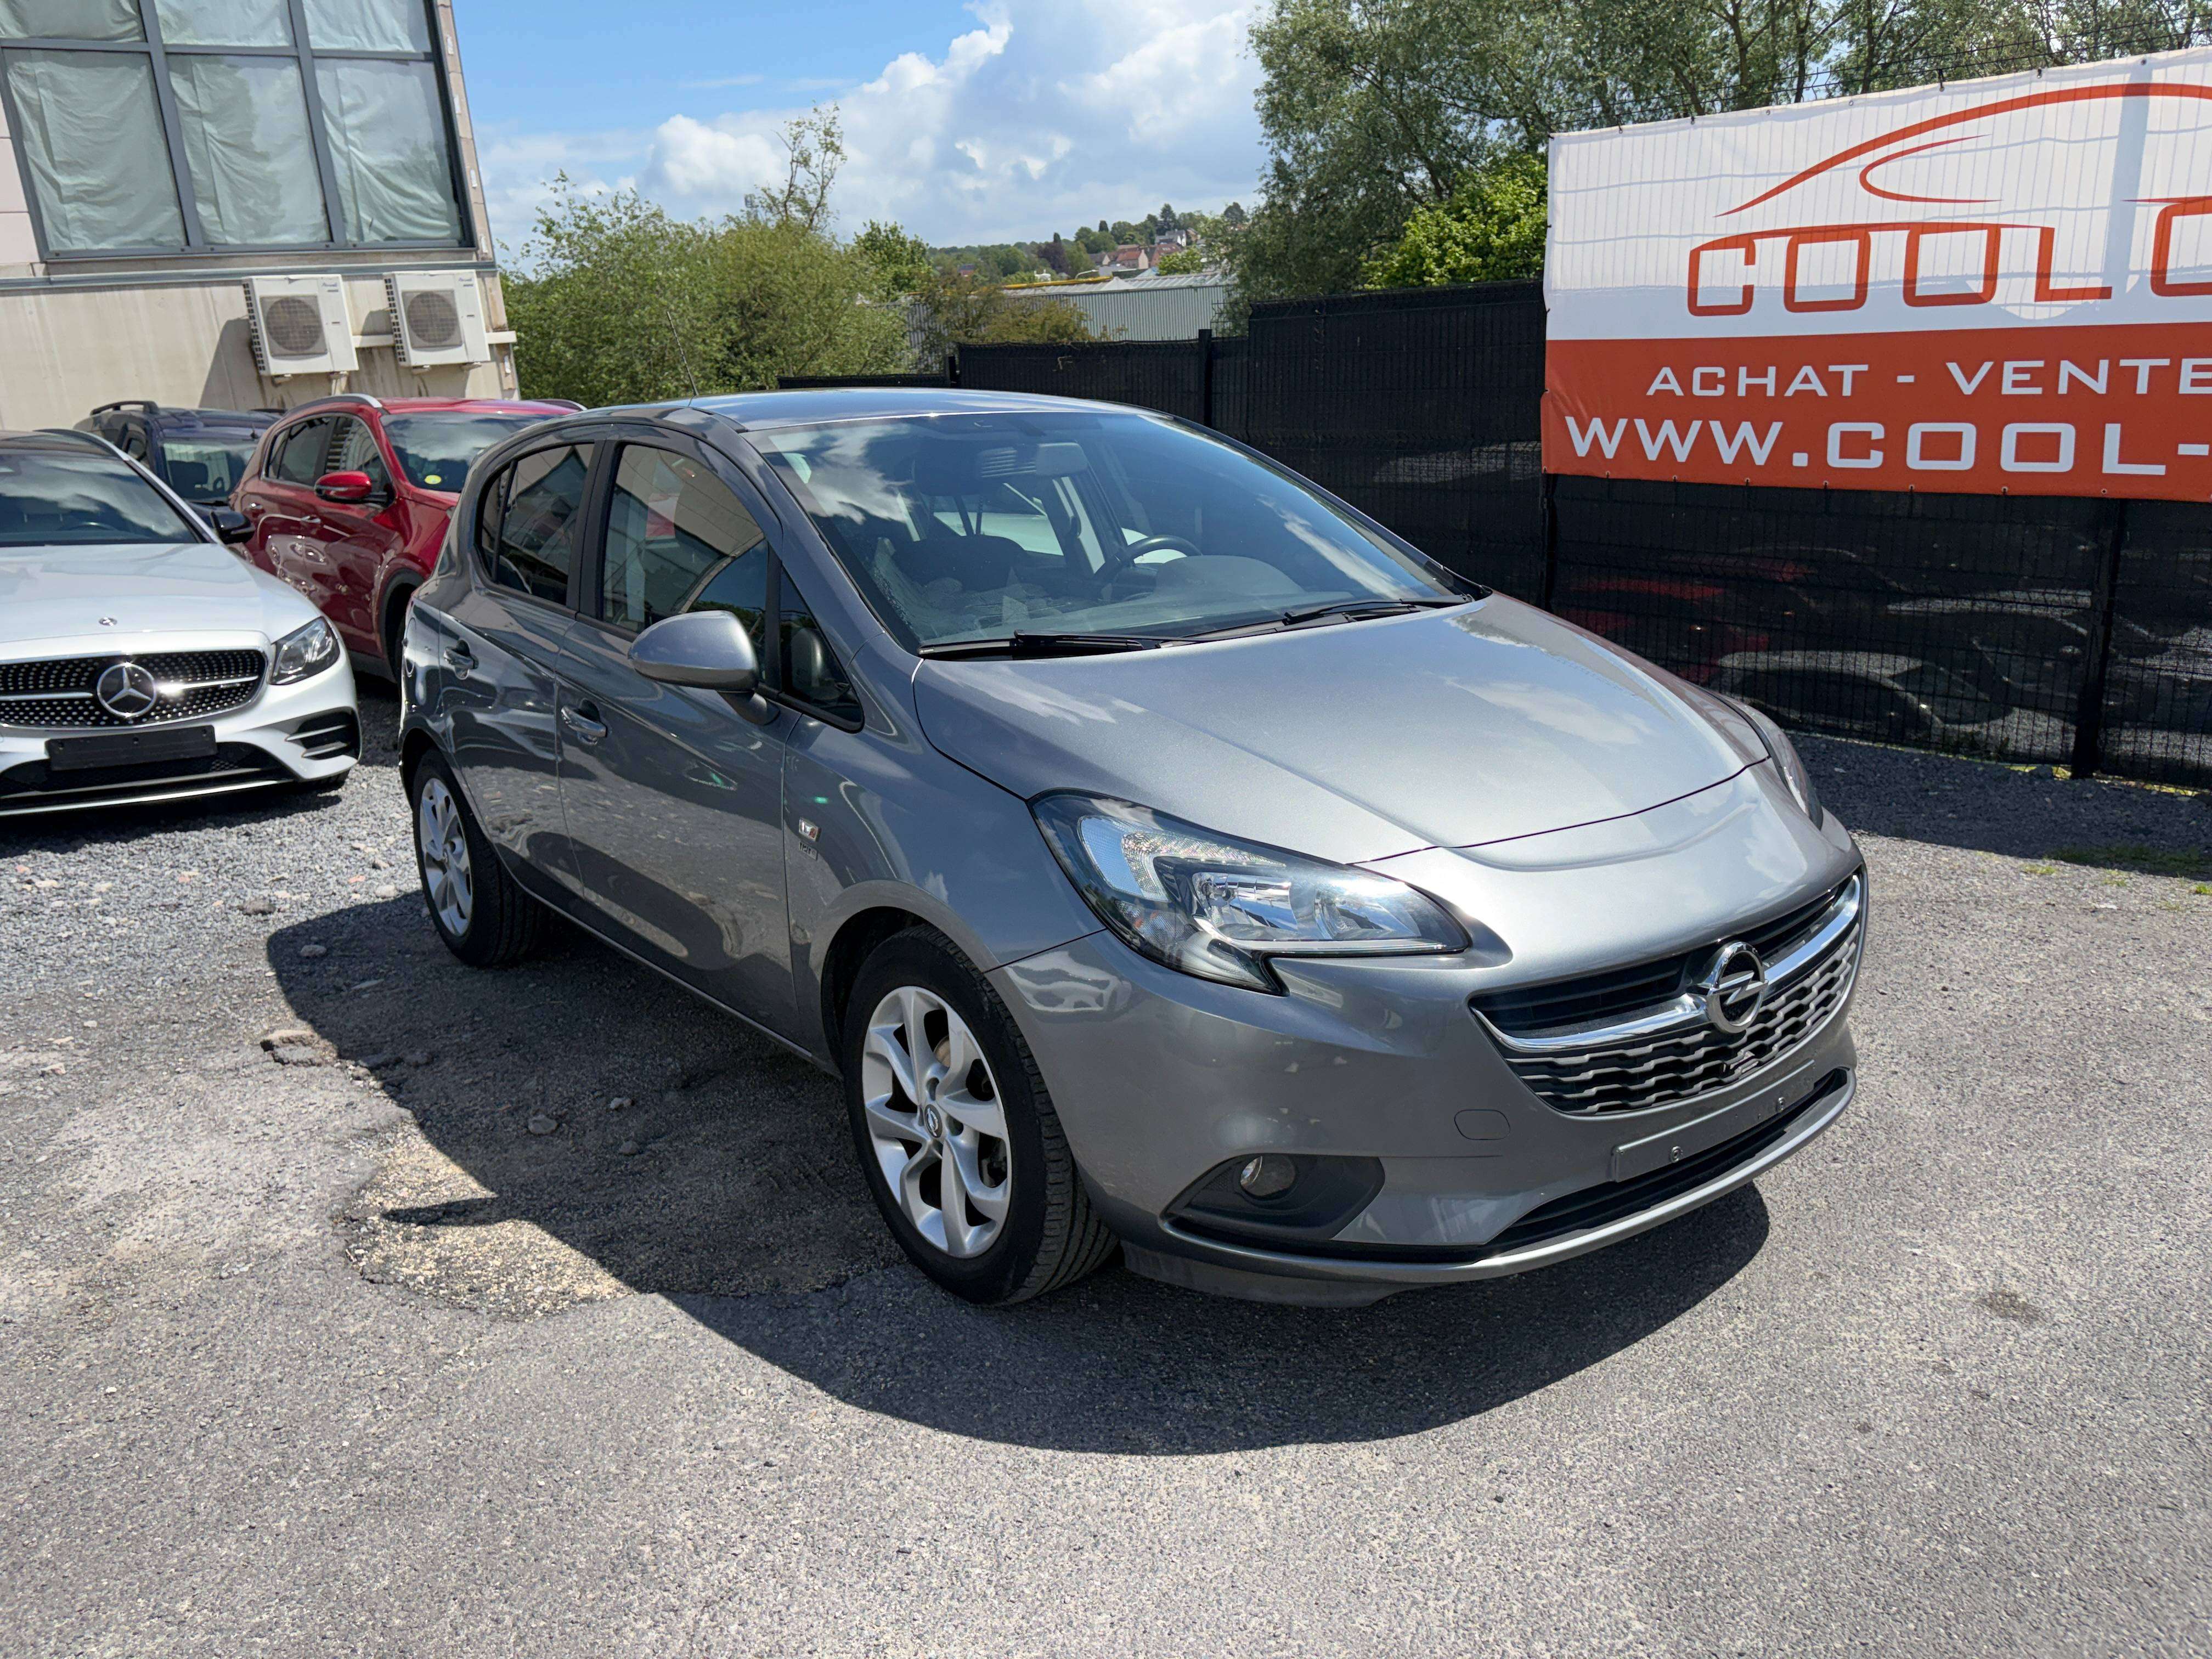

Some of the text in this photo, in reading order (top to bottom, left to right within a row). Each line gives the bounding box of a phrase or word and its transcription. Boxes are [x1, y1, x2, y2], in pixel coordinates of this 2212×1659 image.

[1688, 223, 2112, 317] COOL
[1646, 364, 1869, 397] ACHAT
[1945, 358, 2212, 395] VENTE
